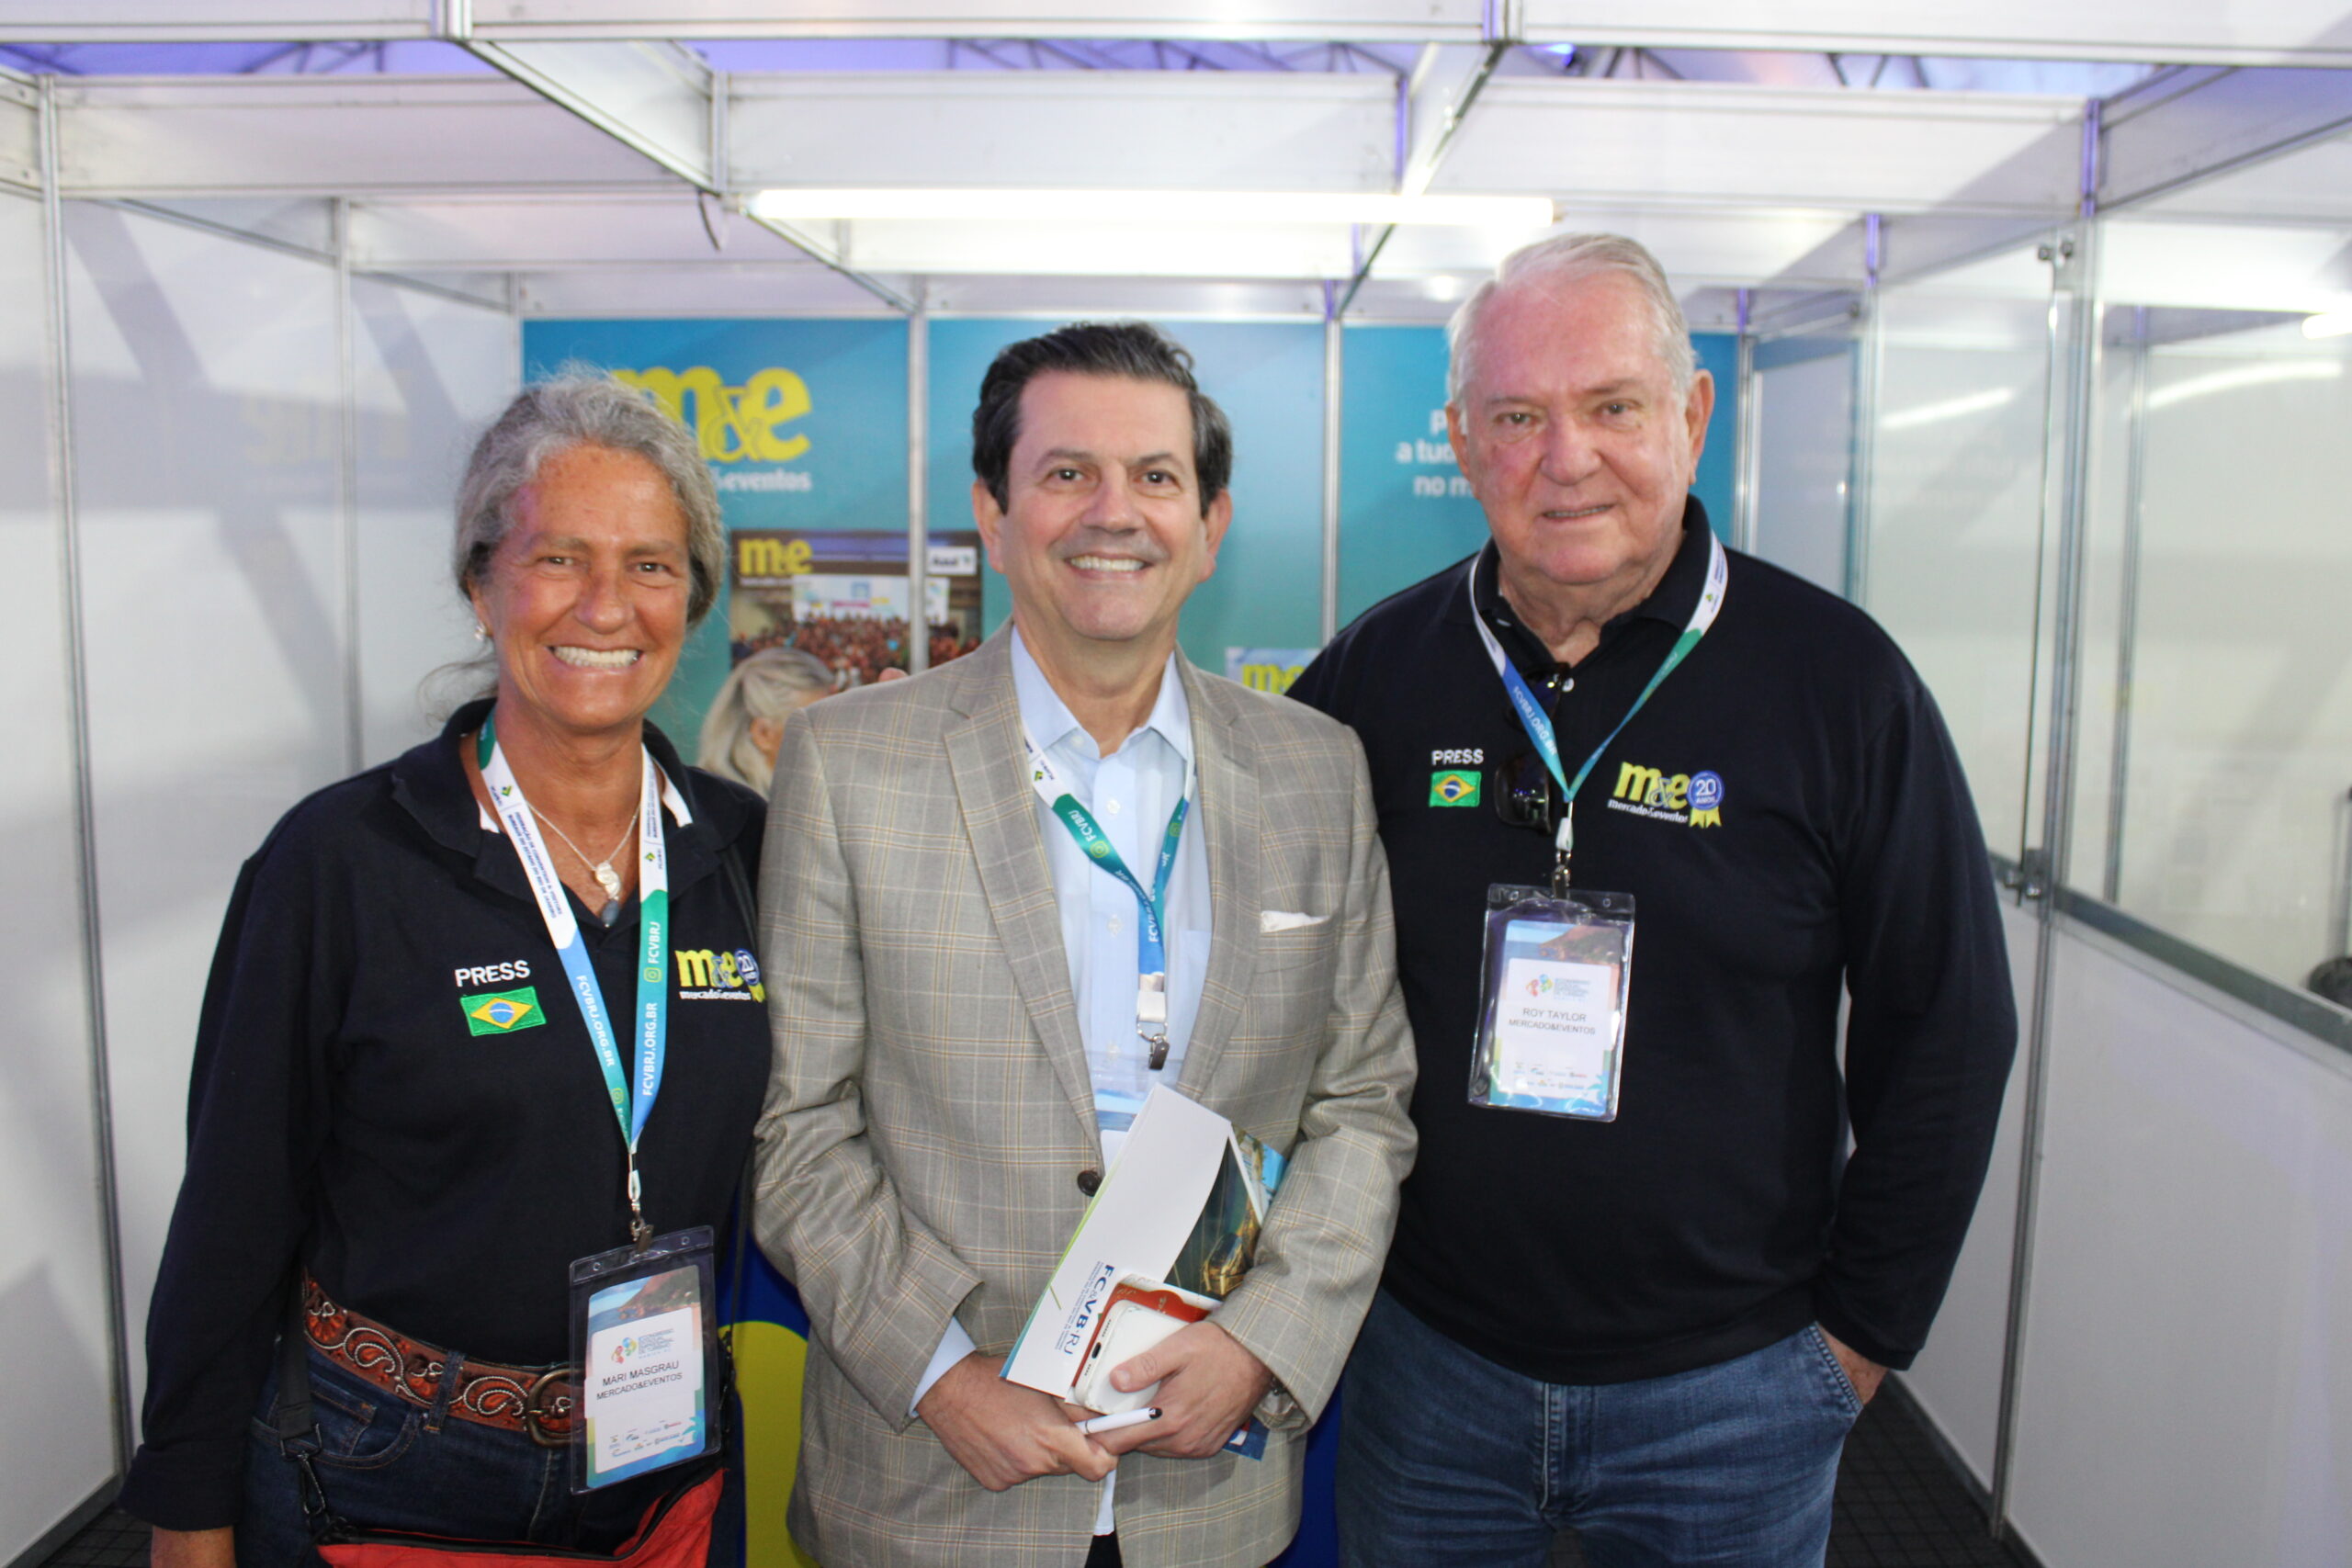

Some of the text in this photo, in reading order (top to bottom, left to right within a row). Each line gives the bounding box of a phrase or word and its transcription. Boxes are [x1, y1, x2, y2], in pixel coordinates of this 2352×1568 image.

[1414, 476, 1445, 497] no
[1431, 749, 1484, 765] PRESS
[1696, 779, 1716, 796] 20
[1068, 809, 1096, 842] FCVBRJ
[648, 921, 662, 964] FCVBRJ
[455, 960, 531, 987] PRESS
[576, 975, 616, 1067] FCVBRJ.ORG.BR
[1509, 1019, 1596, 1035] MERCADO&EVENTOS
[1522, 1007, 1588, 1022] ROY TAYLOR
[642, 1002, 659, 1097] FCVBRJ.ORG.BR
[596, 1372, 683, 1400] MERCADO&EVENTOS
[603, 1360, 680, 1386] MARI MASGRAU
